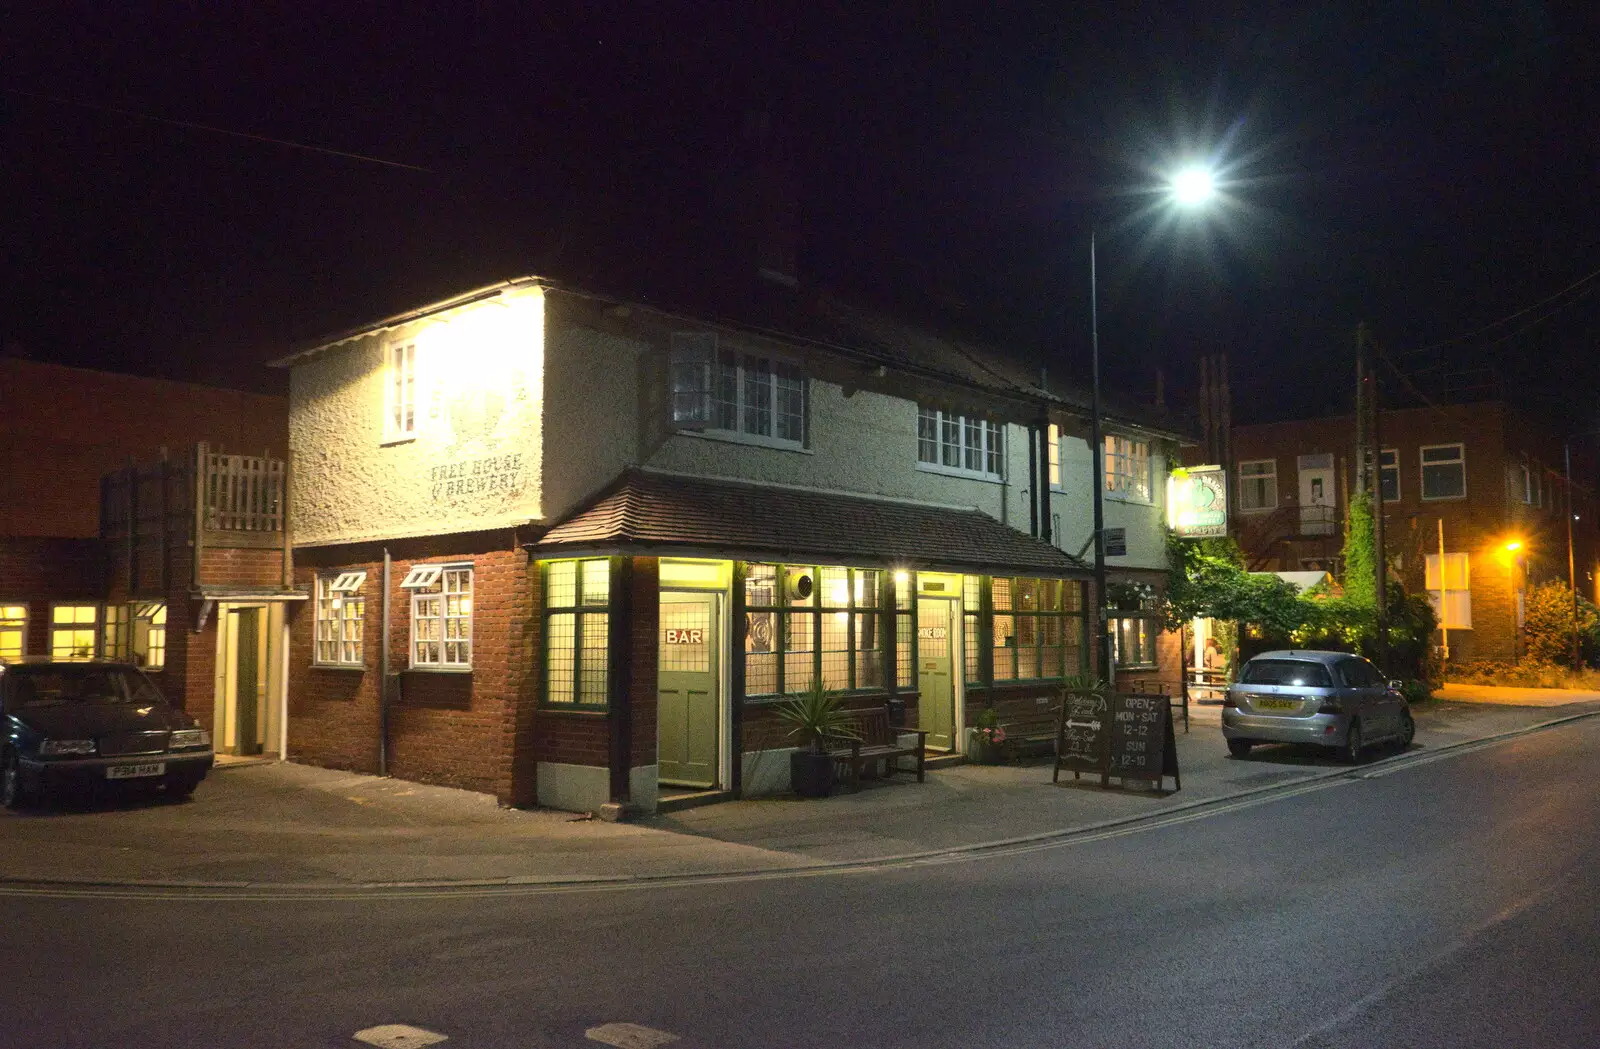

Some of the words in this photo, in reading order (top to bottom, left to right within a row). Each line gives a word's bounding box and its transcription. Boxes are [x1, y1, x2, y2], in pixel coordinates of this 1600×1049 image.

[430, 461, 467, 481] FREE
[472, 453, 523, 475] HOUSE
[446, 471, 519, 496] BREWERY
[666, 630, 702, 644] BAR
[1126, 740, 1146, 752] SUN
